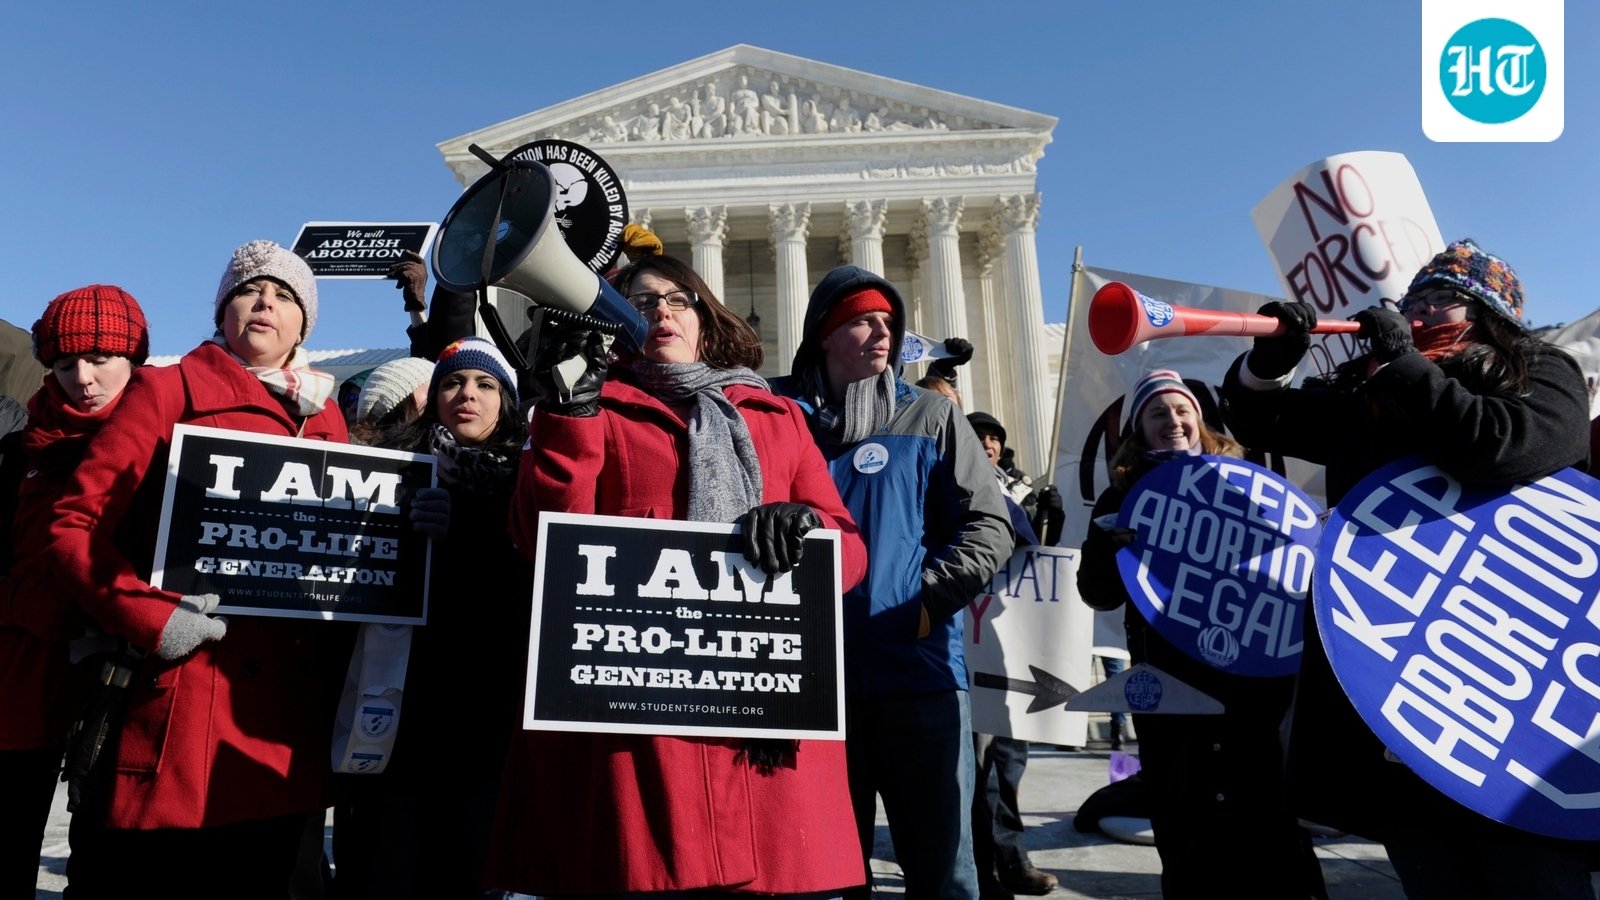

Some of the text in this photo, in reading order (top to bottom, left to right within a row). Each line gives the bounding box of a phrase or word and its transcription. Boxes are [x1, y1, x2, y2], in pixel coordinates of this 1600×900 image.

[546, 145, 568, 160] HAS
[569, 149, 598, 173] BEEN
[593, 167, 621, 203] KILLED
[608, 204, 624, 218] BY
[1293, 163, 1375, 243] NO
[304, 249, 405, 258] ABORTION
[317, 239, 401, 248] ABOLISH
[346, 230, 385, 238] We will
[1286, 216, 1432, 314] FORCED
[205, 454, 402, 514] I AM
[1177, 462, 1318, 536] KEEP
[198, 521, 399, 560] PRO-LIFE
[293, 510, 316, 523] the
[1128, 488, 1315, 595] ABORTIO
[194, 556, 396, 586] GENERATION
[575, 544, 801, 605] I AM
[981, 551, 1074, 602] HAT
[1329, 465, 1477, 663] KEEP
[675, 606, 703, 620] the
[1136, 549, 1304, 660] LEGAL
[571, 623, 802, 660] PRO-LIFE
[1380, 475, 1600, 787] ABORTION
[570, 664, 802, 693] GENERATION
[609, 701, 764, 716] WWW.STUDENTSFORLIFE.ORG
